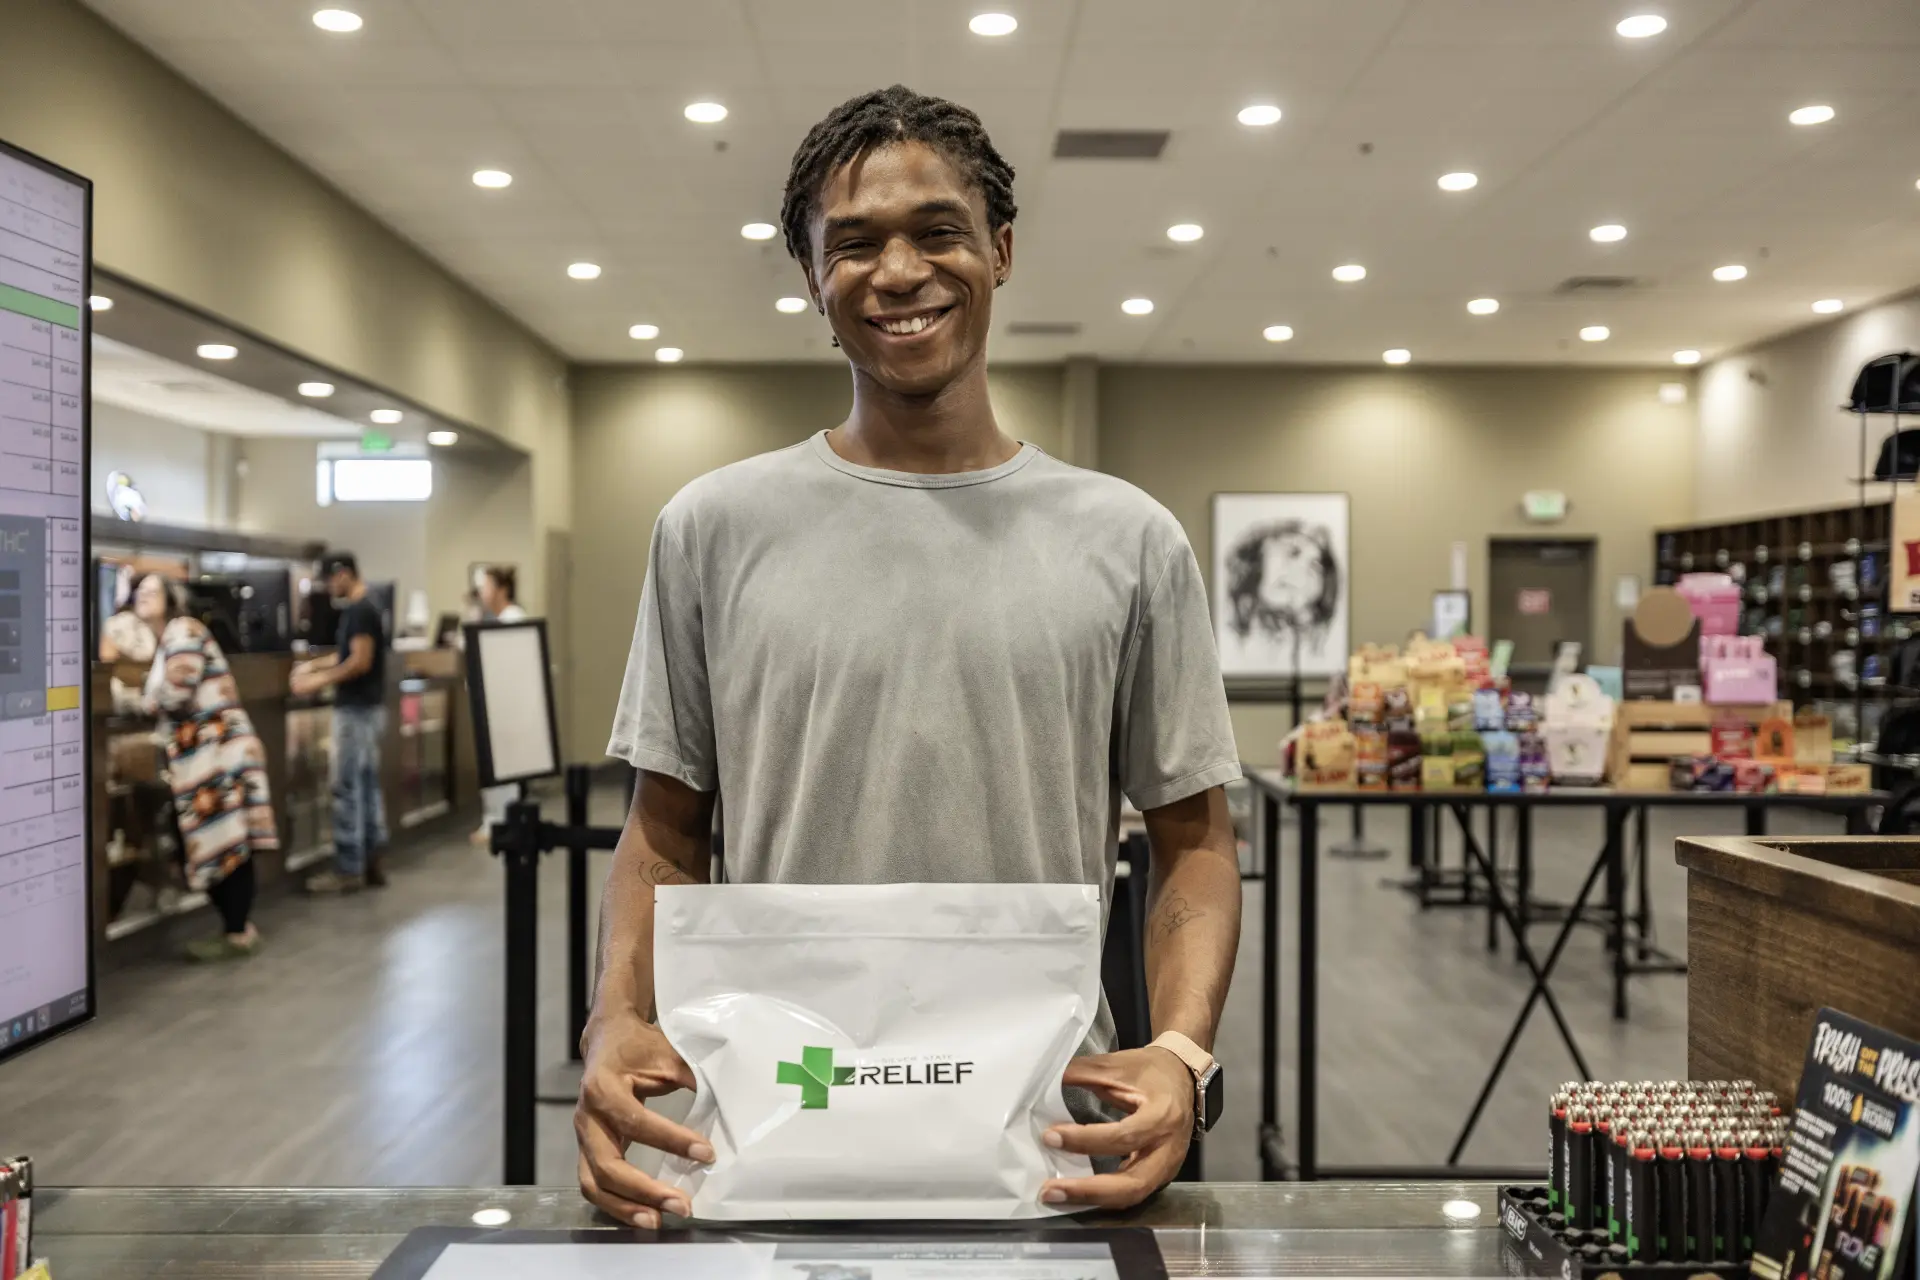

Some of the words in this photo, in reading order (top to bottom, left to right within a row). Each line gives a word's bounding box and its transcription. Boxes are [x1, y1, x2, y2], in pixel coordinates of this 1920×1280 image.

[1813, 1021, 1862, 1075] FRESH
[860, 1062, 974, 1085] RELIEF
[1874, 1047, 1920, 1103] PRES
[1823, 1082, 1854, 1115] 100%
[1507, 1209, 1526, 1236] BIC
